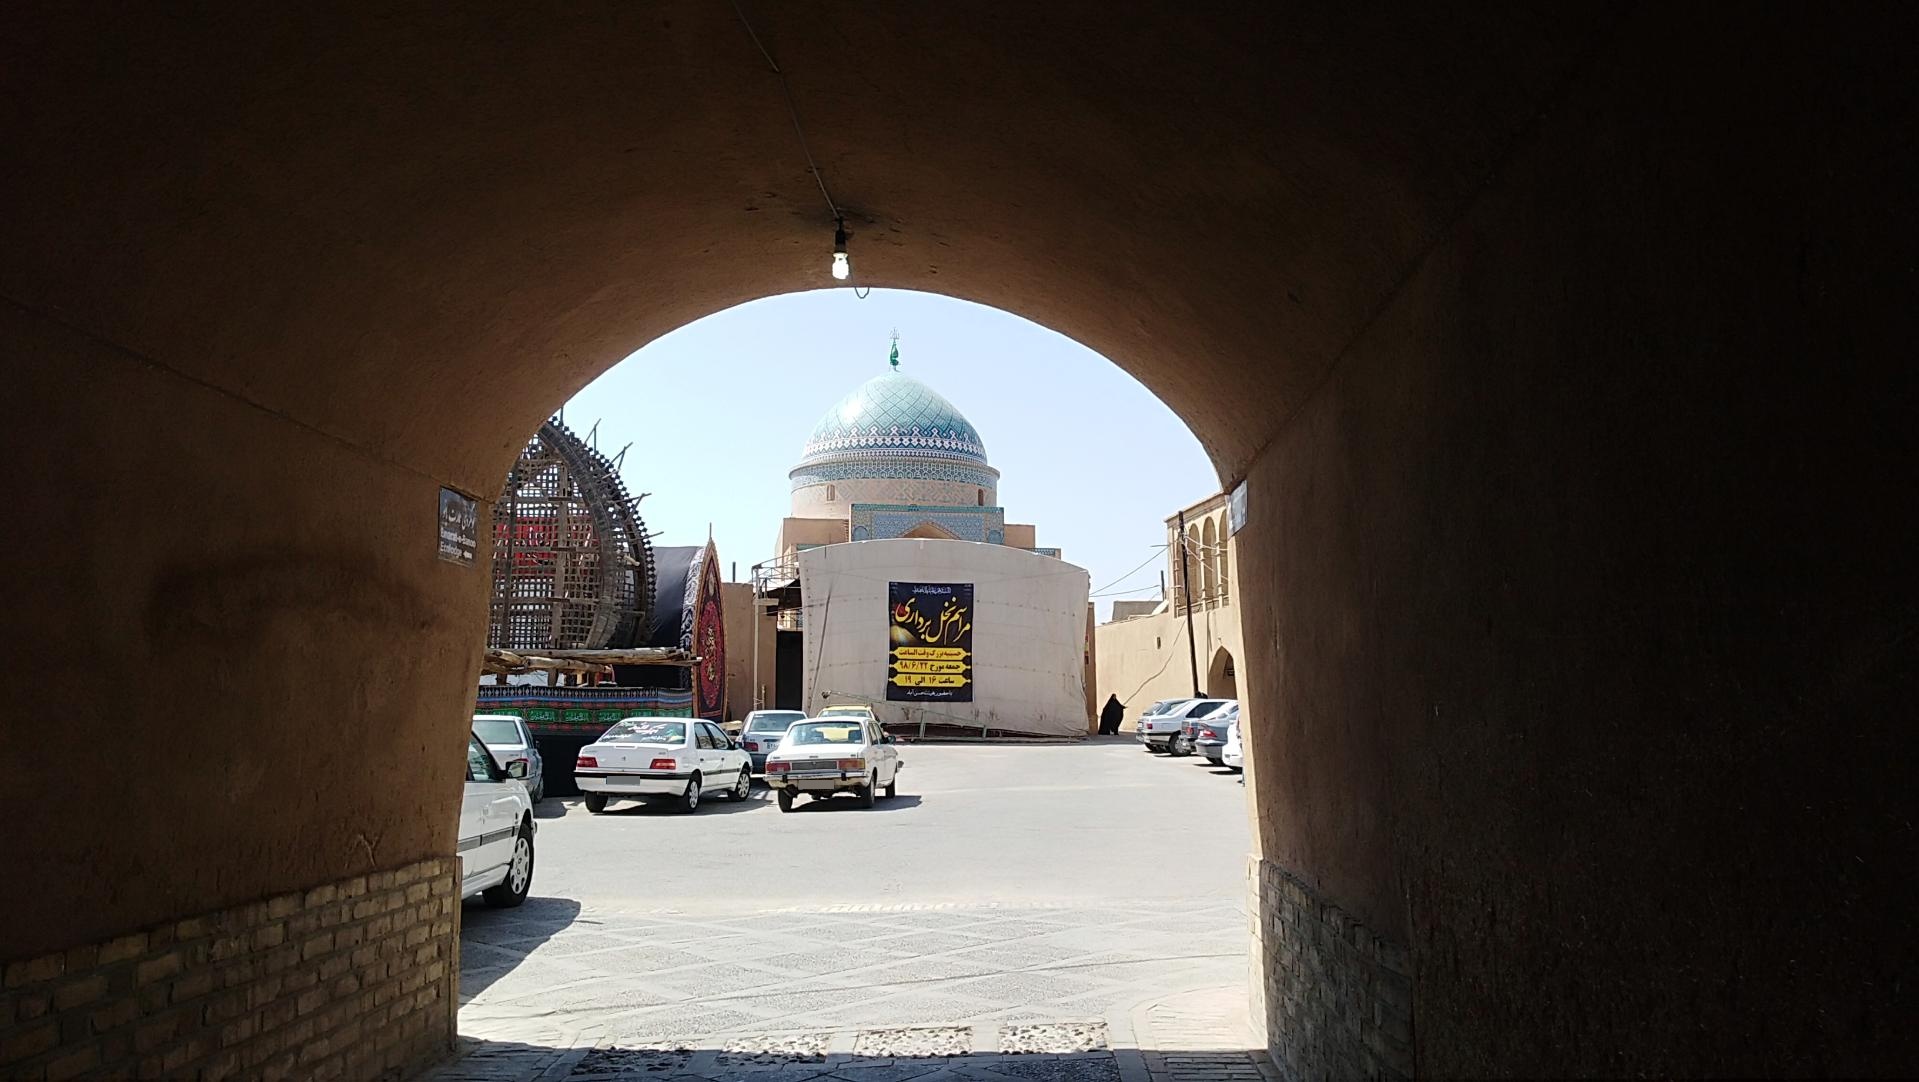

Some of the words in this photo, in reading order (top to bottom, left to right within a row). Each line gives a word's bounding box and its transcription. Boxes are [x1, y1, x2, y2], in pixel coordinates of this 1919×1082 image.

[895, 597, 932, 640] برداری
[926, 597, 957, 643] نخل
[945, 606, 971, 645] مراسم
[938, 676, 955, 684] ساعت
